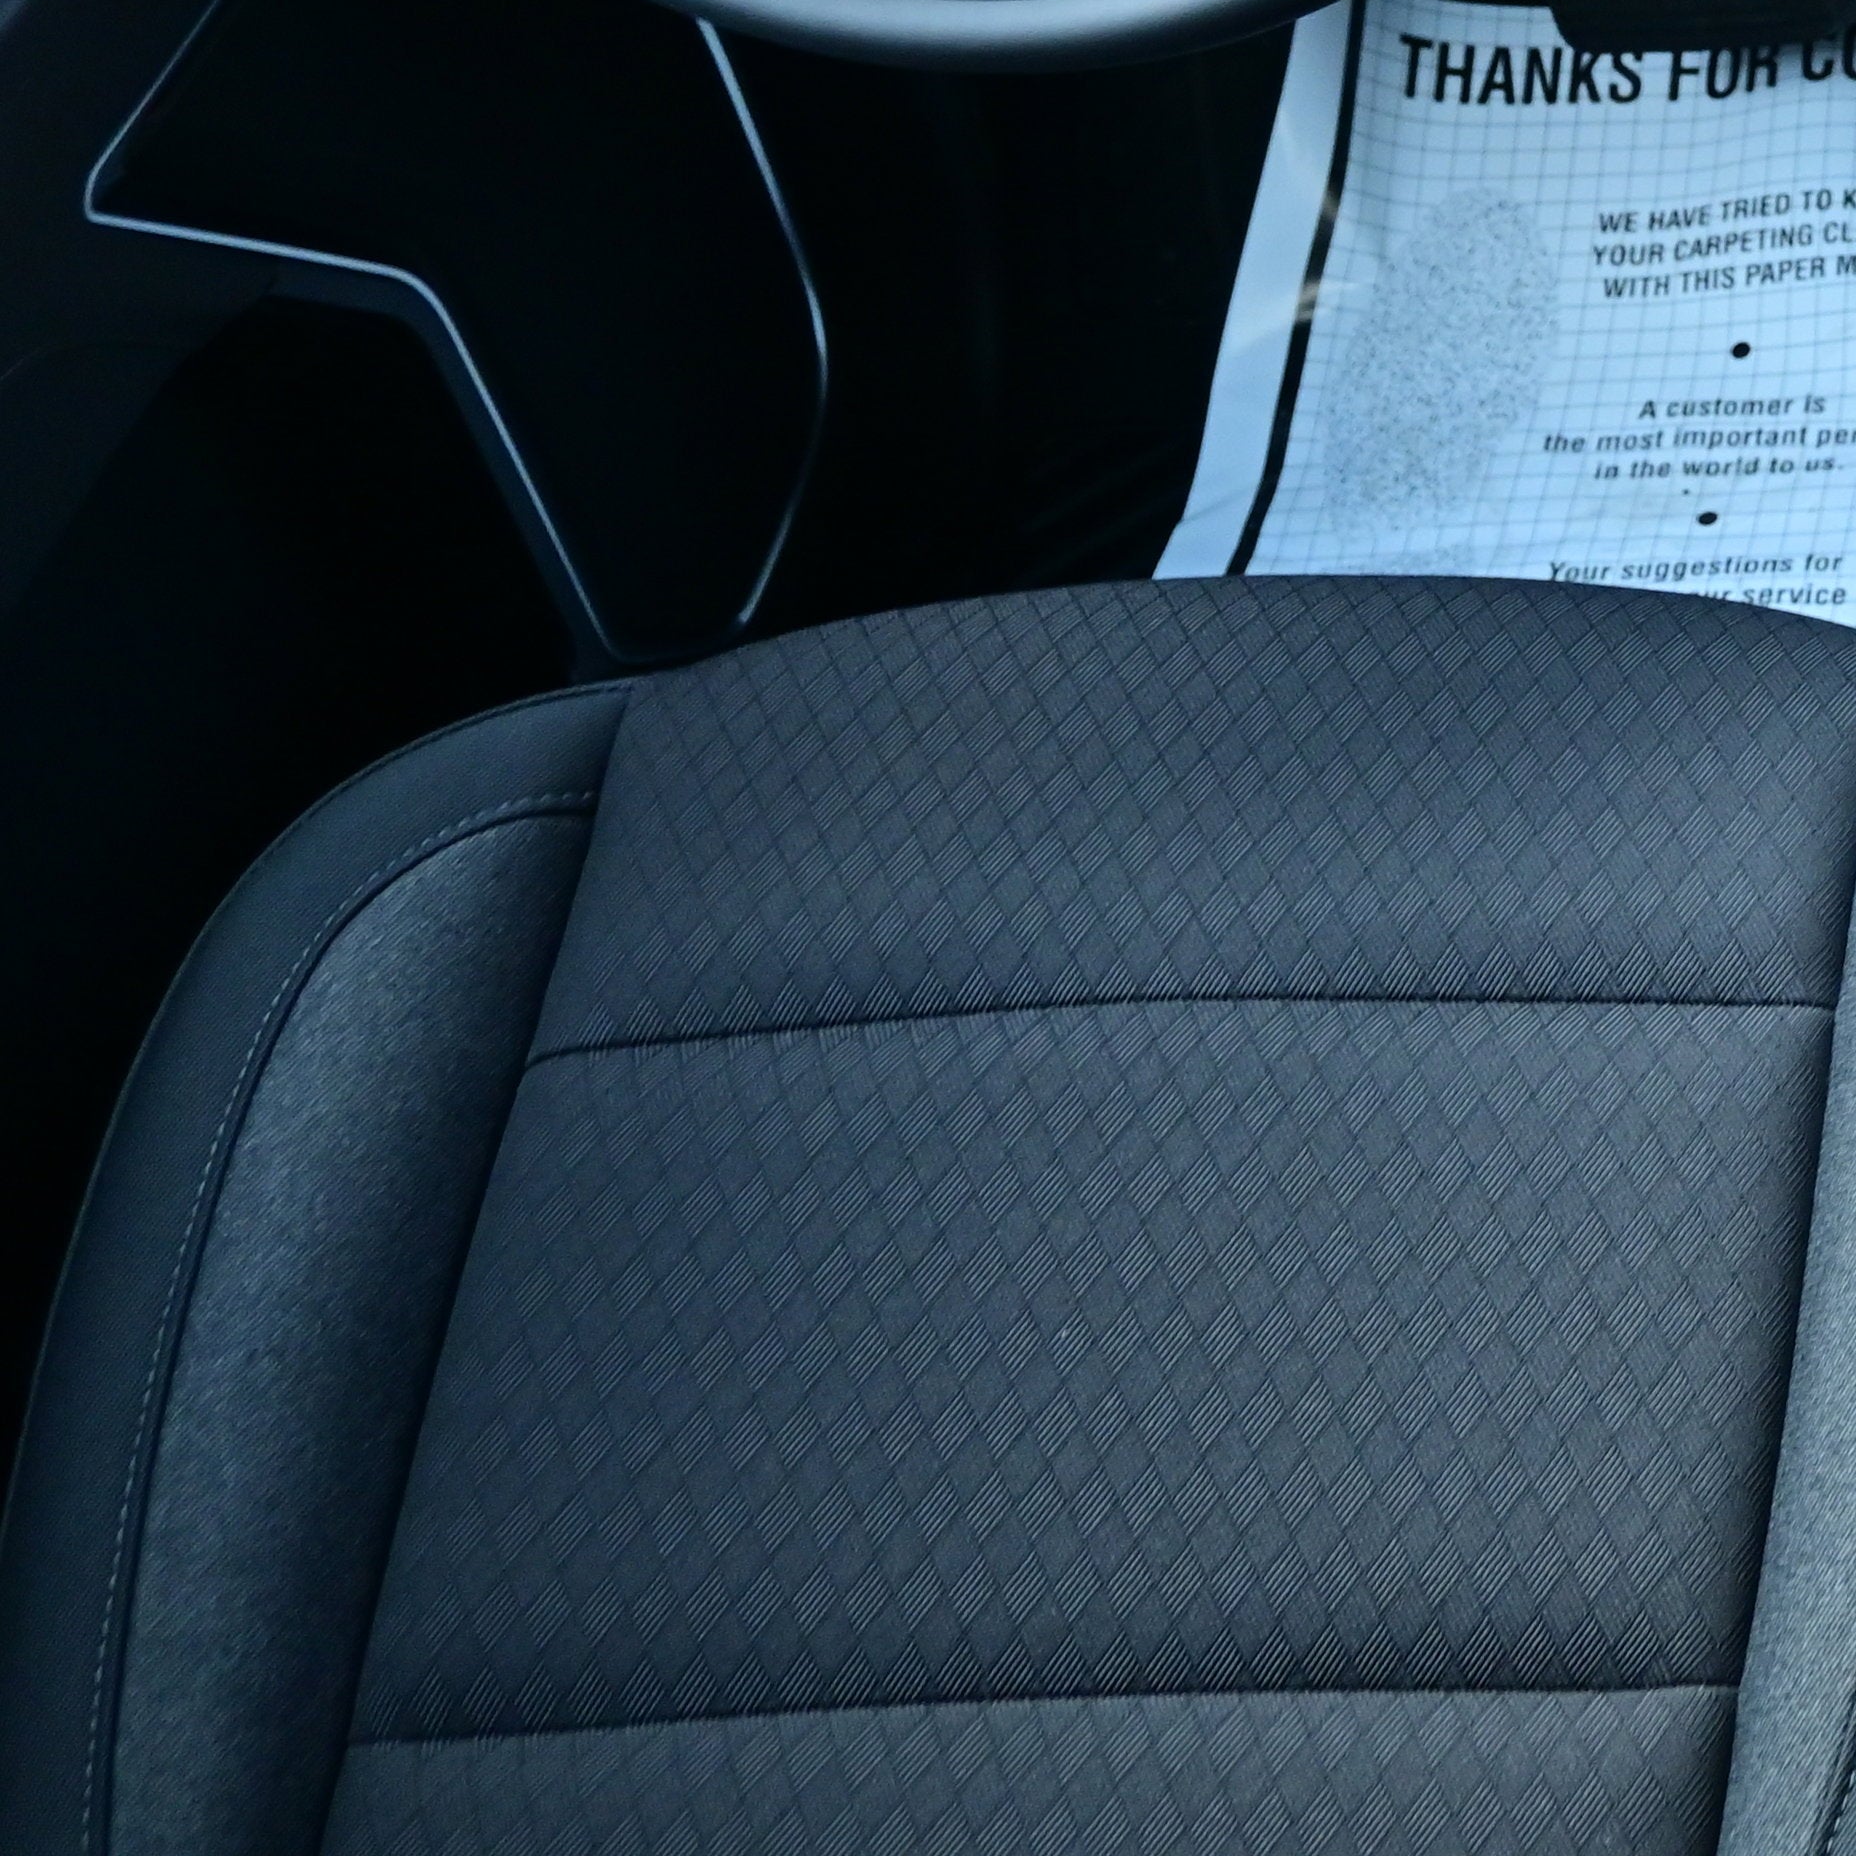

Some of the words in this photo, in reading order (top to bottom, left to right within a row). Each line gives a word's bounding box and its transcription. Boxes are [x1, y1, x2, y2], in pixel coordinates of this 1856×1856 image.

[1400, 33, 1643, 105] THANKS
[1668, 42, 1779, 101] FOR
[1600, 212, 1638, 233] WE
[1648, 204, 1711, 231] HAVE
[1721, 193, 1791, 223] TRIED
[1802, 188, 1832, 211] TO
[1592, 243, 1664, 266] YOUR
[1673, 223, 1814, 262] CARPETING
[1603, 274, 1670, 299] WITH
[1681, 265, 1735, 293] THIS
[1745, 255, 1825, 287] PAPER
[1638, 400, 1656, 419] A
[1666, 397, 1793, 418] customer
[1803, 395, 1826, 415] is
[1543, 432, 1583, 454] the
[1595, 430, 1664, 452] most
[1673, 427, 1808, 450] important
[1594, 461, 1618, 480] in
[1629, 460, 1670, 479] the
[1682, 457, 1760, 477] world
[1769, 456, 1794, 474] to
[1805, 456, 1843, 472] us.
[1549, 561, 1610, 583] Your
[1621, 556, 1793, 583] suggestions
[1804, 554, 1843, 572] for
[1742, 583, 1847, 606] service
